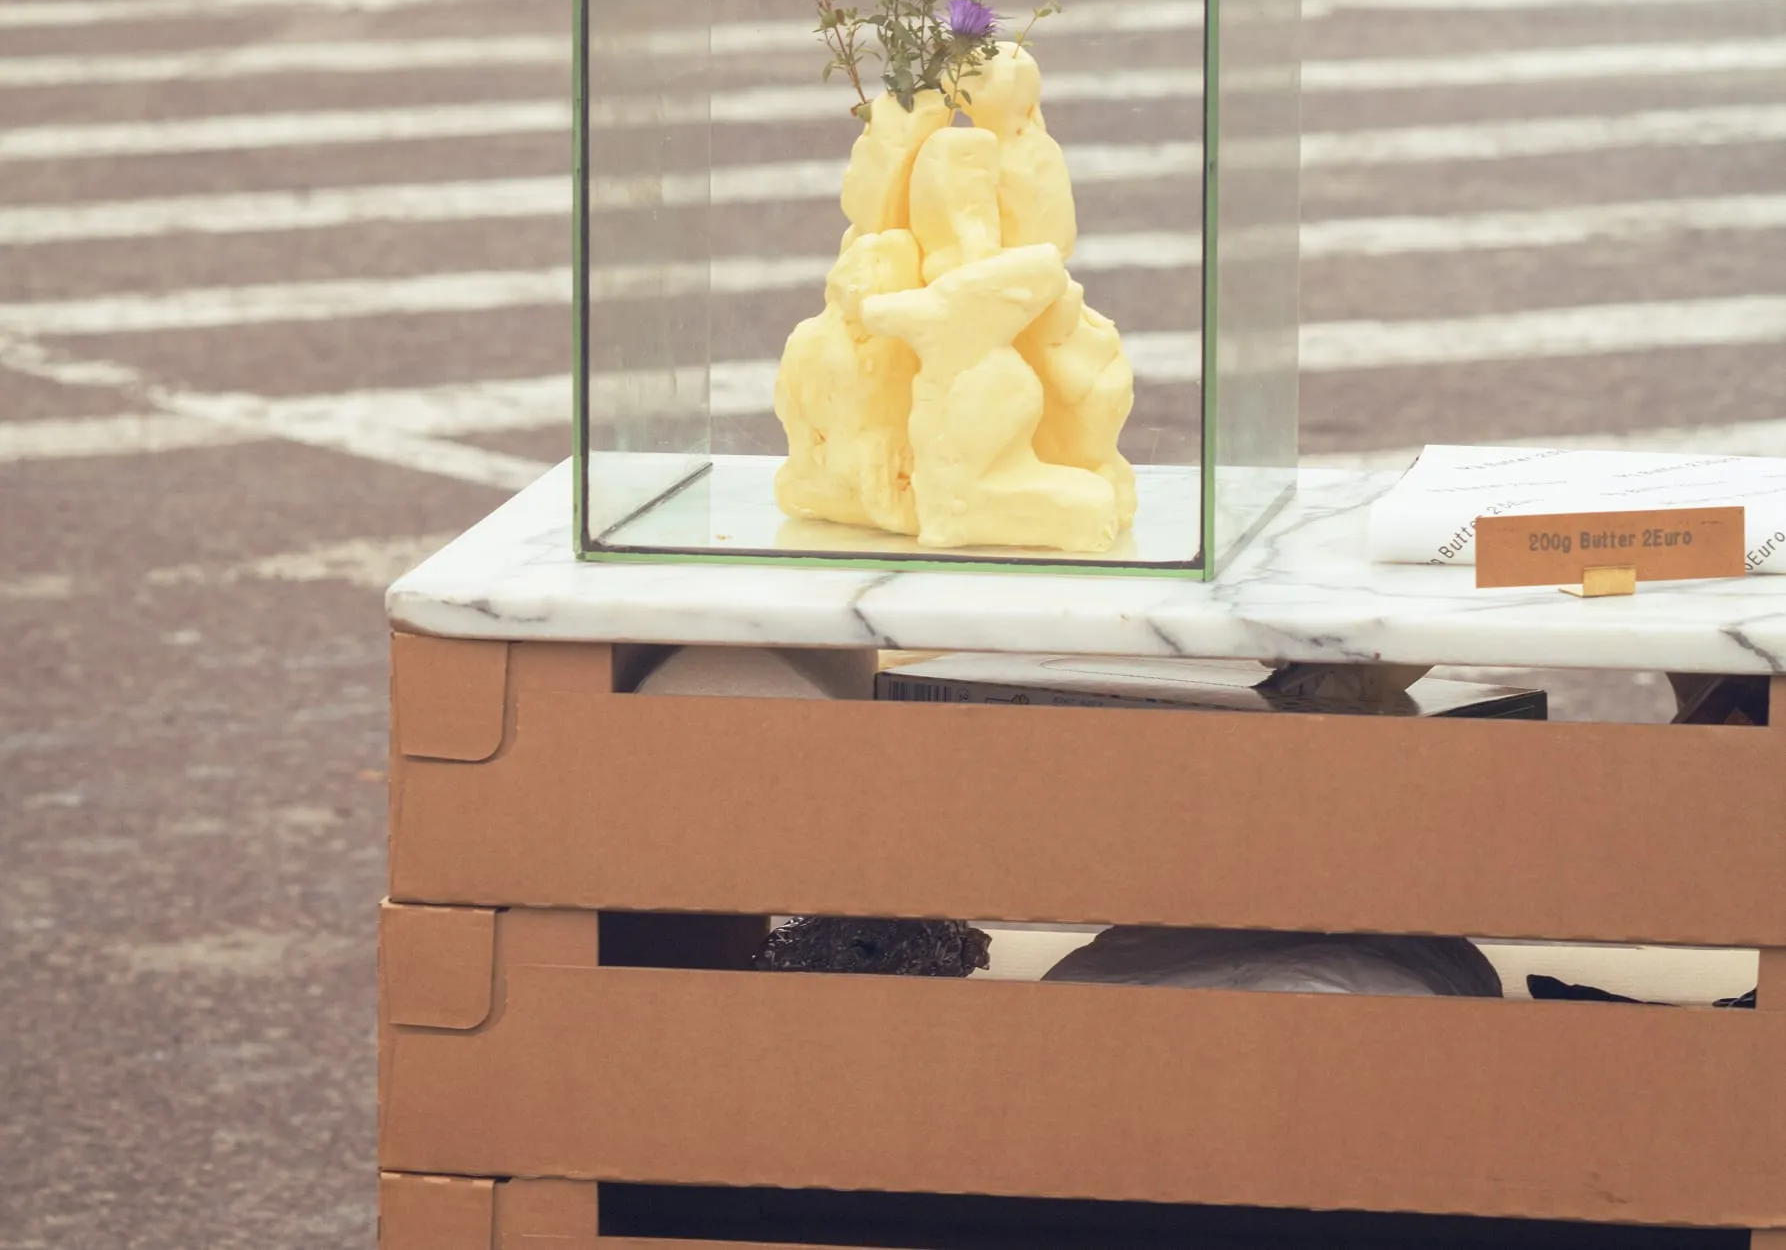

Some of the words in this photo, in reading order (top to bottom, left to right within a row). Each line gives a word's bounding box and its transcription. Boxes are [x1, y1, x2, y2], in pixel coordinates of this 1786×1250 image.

[1528, 532, 1572, 554] 200g
[1580, 530, 1637, 549] Butter
[1642, 528, 1693, 547] 2Euro
